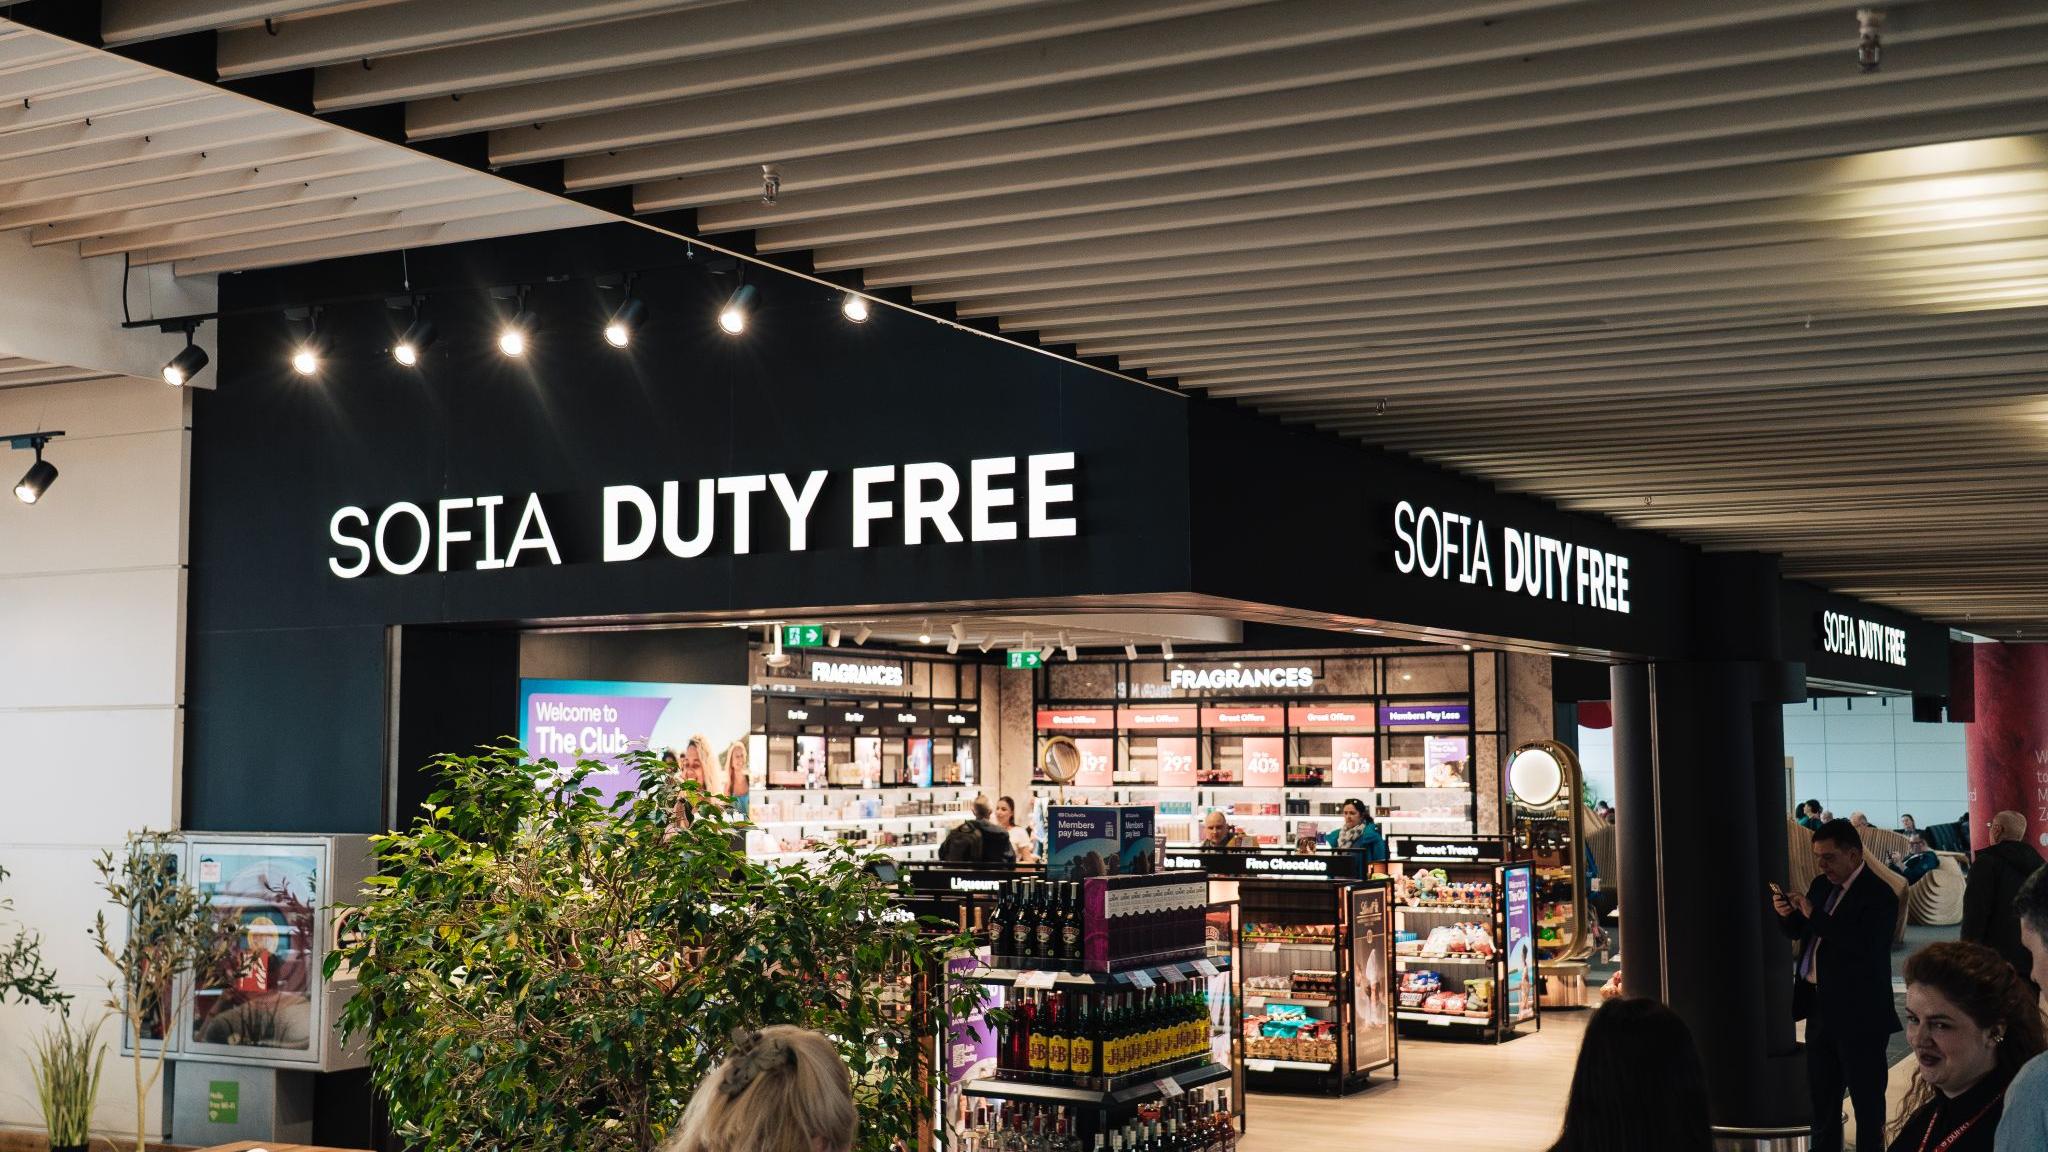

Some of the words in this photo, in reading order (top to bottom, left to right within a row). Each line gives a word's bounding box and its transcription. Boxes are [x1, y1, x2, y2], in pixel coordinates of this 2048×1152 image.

[328, 492, 562, 579] SOFIA
[603, 469, 829, 563] DUTY
[852, 451, 1077, 548] FREE
[1394, 500, 1493, 587] SOFIA
[1504, 526, 1573, 602] DUTY
[1576, 545, 1630, 614] FREE
[1823, 610, 1857, 657] SOFIA
[1858, 619, 1884, 661] DUTY
[1884, 625, 1906, 667] FREE
[812, 661, 903, 686] FRAGRANCES
[1169, 667, 1314, 689] FRAGRANCES
[535, 701, 602, 722] Welcome
[602, 703, 618, 722] to
[1155, 714, 1180, 723] Offers
[1241, 712, 1266, 722] Offers
[1329, 712, 1356, 722] Offers
[1073, 715, 1097, 724] Offers
[534, 726, 577, 754] The
[580, 726, 629, 755] Club
[1247, 757, 1280, 773] 40%
[1336, 757, 1371, 773] 40%
[1058, 820, 1095, 829] Members
[1072, 829, 1088, 837] less
[1415, 844, 1446, 855] Sweet
[1447, 844, 1479, 856] Treats
[1175, 856, 1201, 868] Bars
[1245, 857, 1269, 870] Fine
[1270, 858, 1327, 872] Chocolate
[950, 877, 1000, 892] Liqueurs
